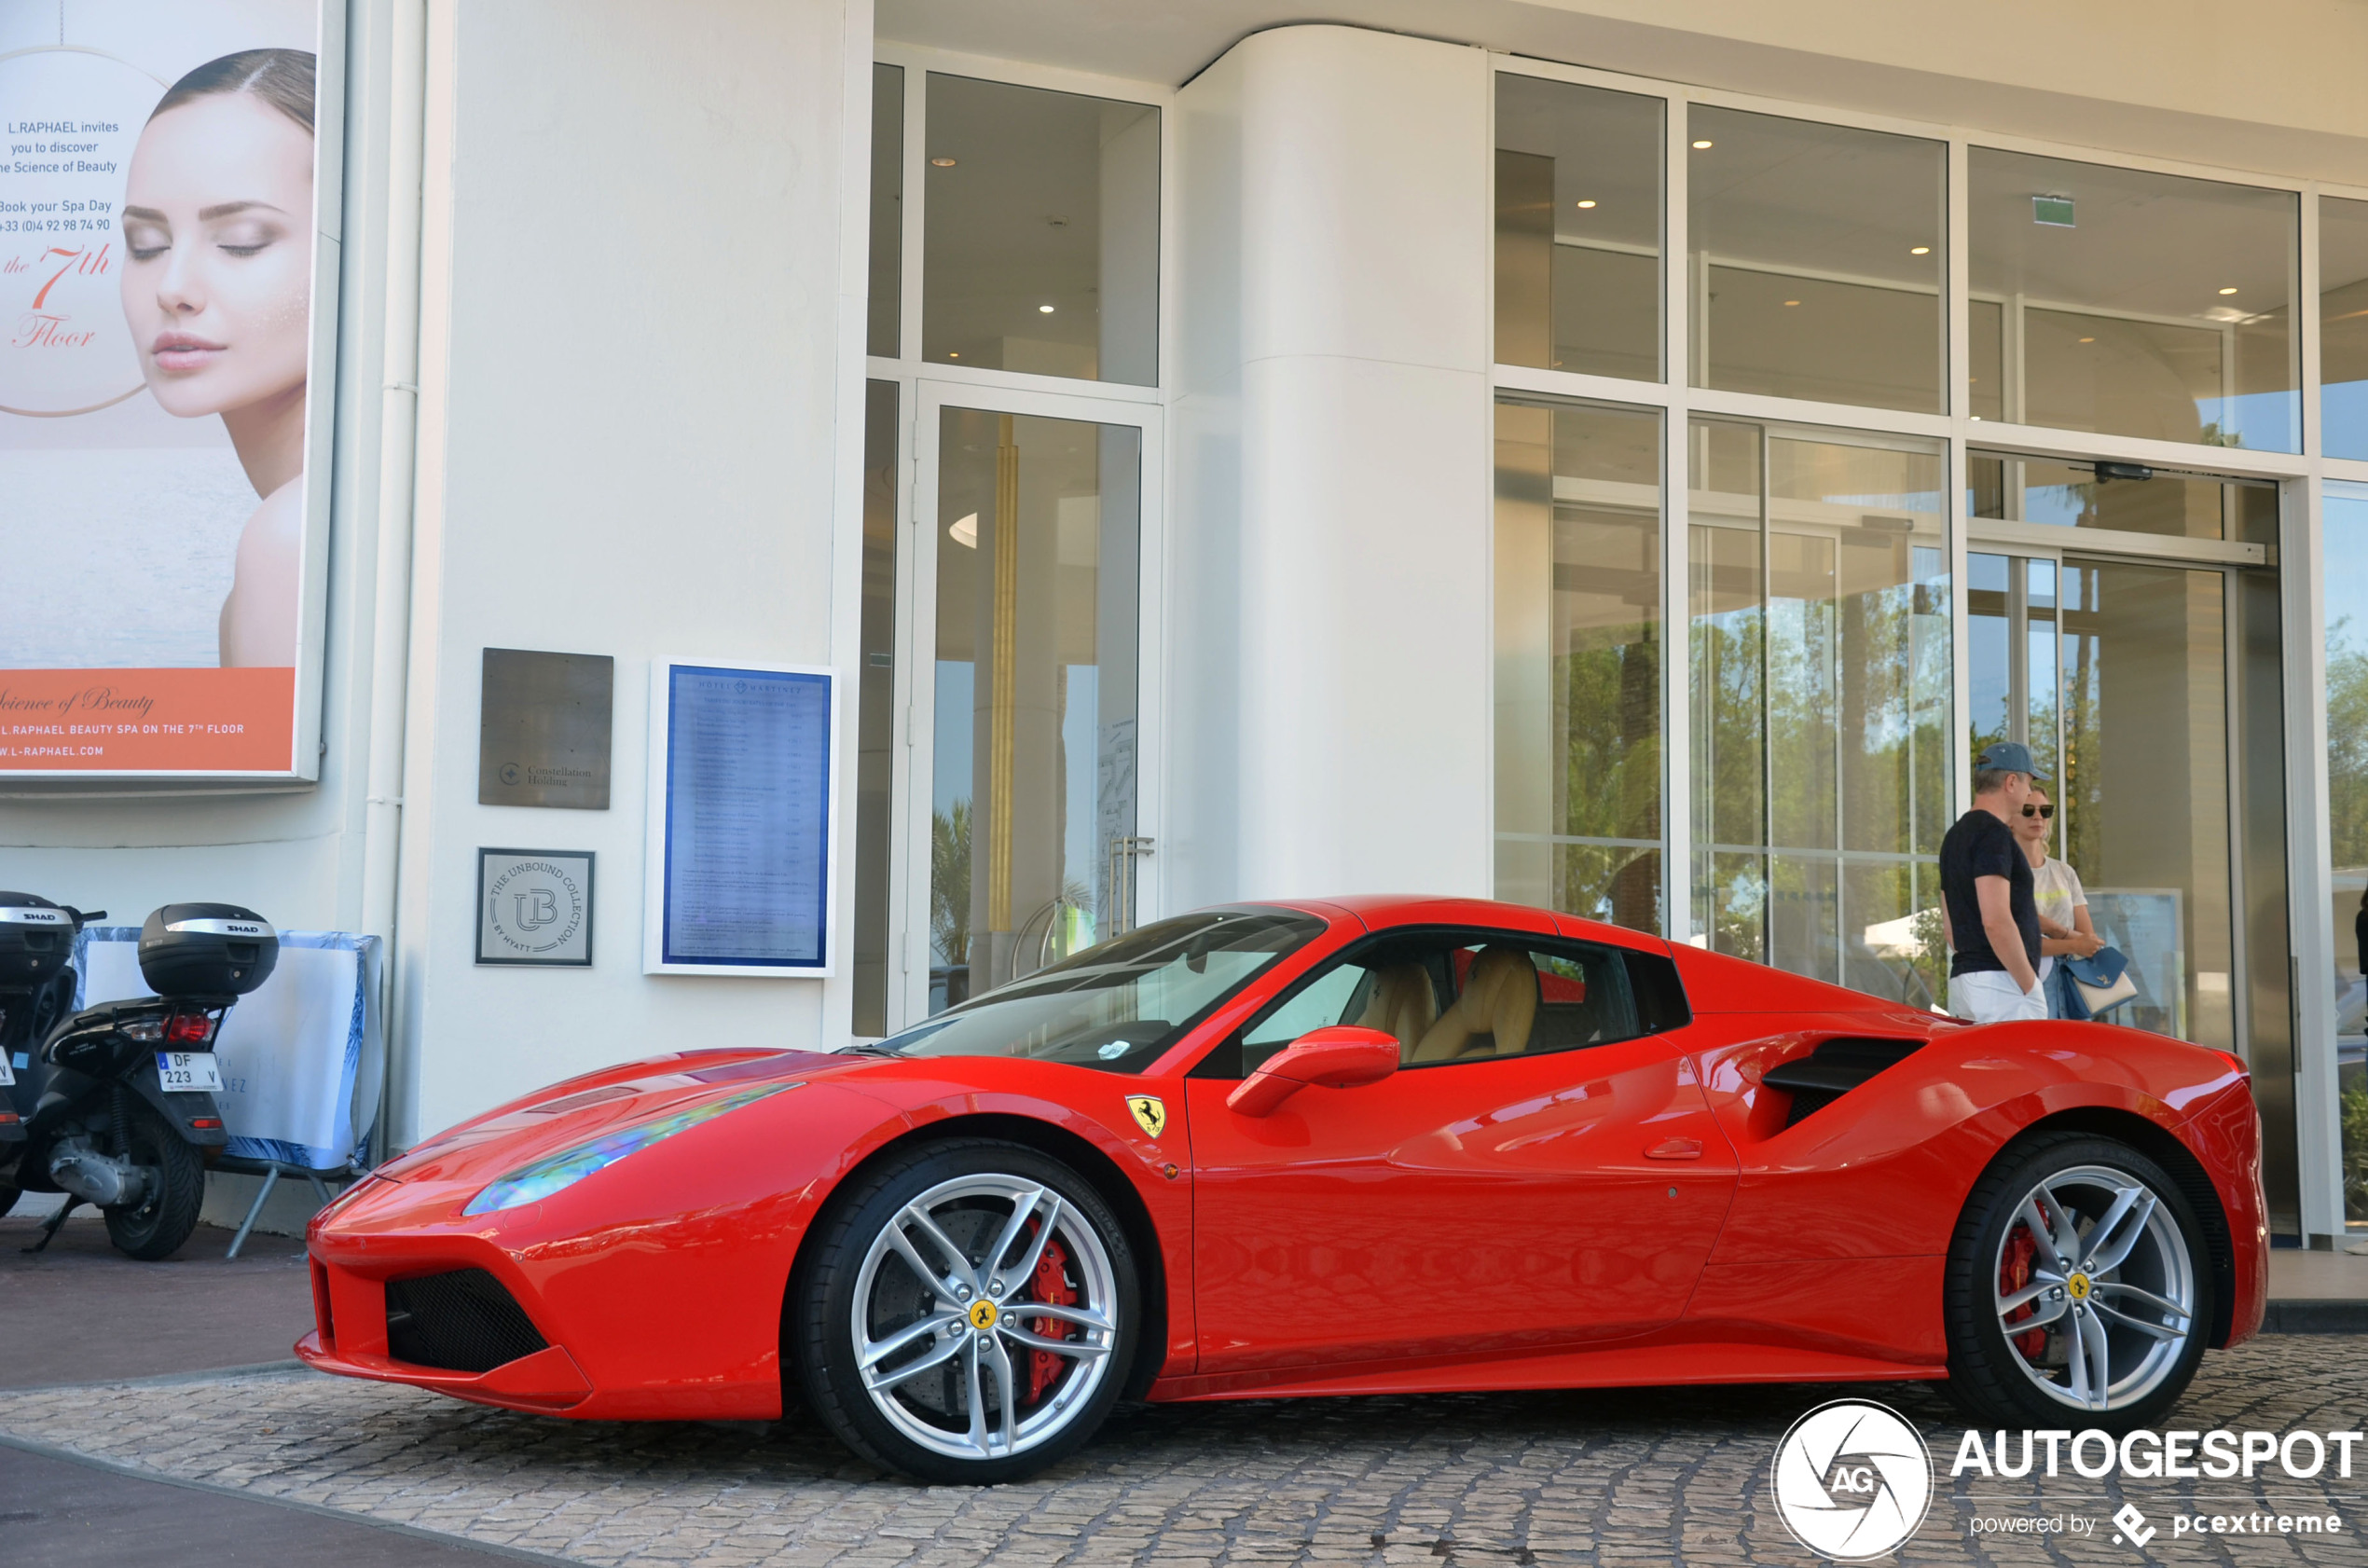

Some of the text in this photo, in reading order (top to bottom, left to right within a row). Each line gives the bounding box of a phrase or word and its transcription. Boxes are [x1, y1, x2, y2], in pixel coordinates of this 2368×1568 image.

[8, 121, 118, 133] L.RAPHAEL invites
[11, 142, 99, 156] you to discover
[14, 161, 59, 172] Science
[62, 160, 74, 172] of
[77, 160, 117, 174] Beauty
[0, 199, 112, 214] Book your Spa Day
[22, 220, 43, 232] (0)4
[47, 220, 60, 231] 92
[63, 220, 76, 230] 98
[80, 219, 93, 230] 74
[96, 219, 110, 230] 90
[3, 255, 30, 274] the
[11, 312, 96, 349] Floor
[58, 691, 81, 720] of
[81, 686, 154, 720] Beauty
[2, 725, 65, 735] L.RAPHAEL
[70, 724, 113, 735] BEAUTY
[117, 724, 138, 734] SPA
[143, 724, 158, 734] ON
[163, 724, 184, 734] THE
[207, 724, 244, 734] FLOOR
[528, 765, 591, 777] Constellation
[528, 775, 568, 786] Holding
[490, 862, 582, 945] THE UNBOUND COLLECTION
[227, 925, 258, 933] SHAD
[494, 925, 530, 952] BY HYATT
[174, 1054, 191, 1066] DF
[165, 1071, 215, 1082] 223 V
